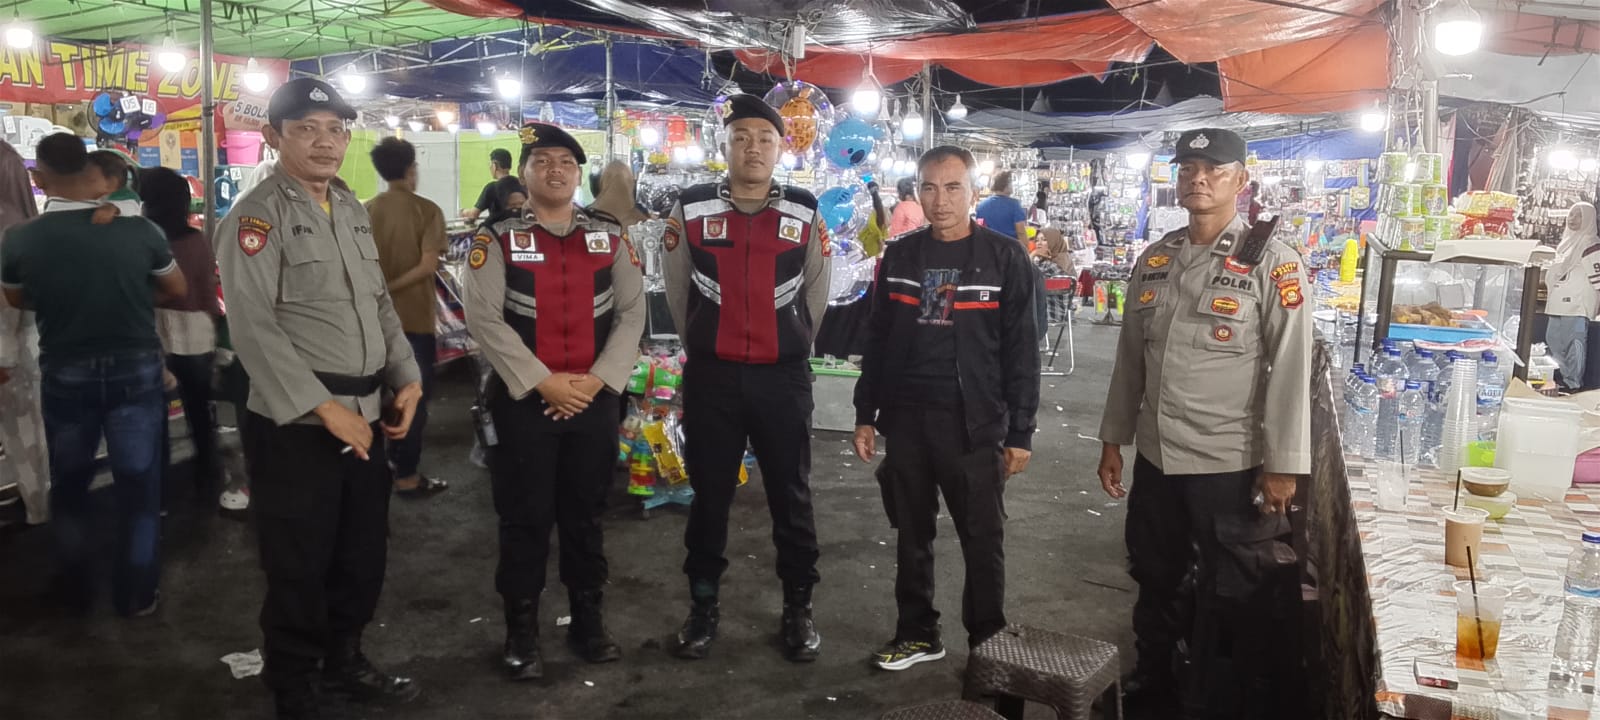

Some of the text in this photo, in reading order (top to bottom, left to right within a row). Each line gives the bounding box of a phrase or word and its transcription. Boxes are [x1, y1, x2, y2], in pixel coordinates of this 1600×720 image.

[51, 42, 151, 94] TIME
[235, 102, 241, 112] 5
[1211, 275, 1252, 291] POLRI
